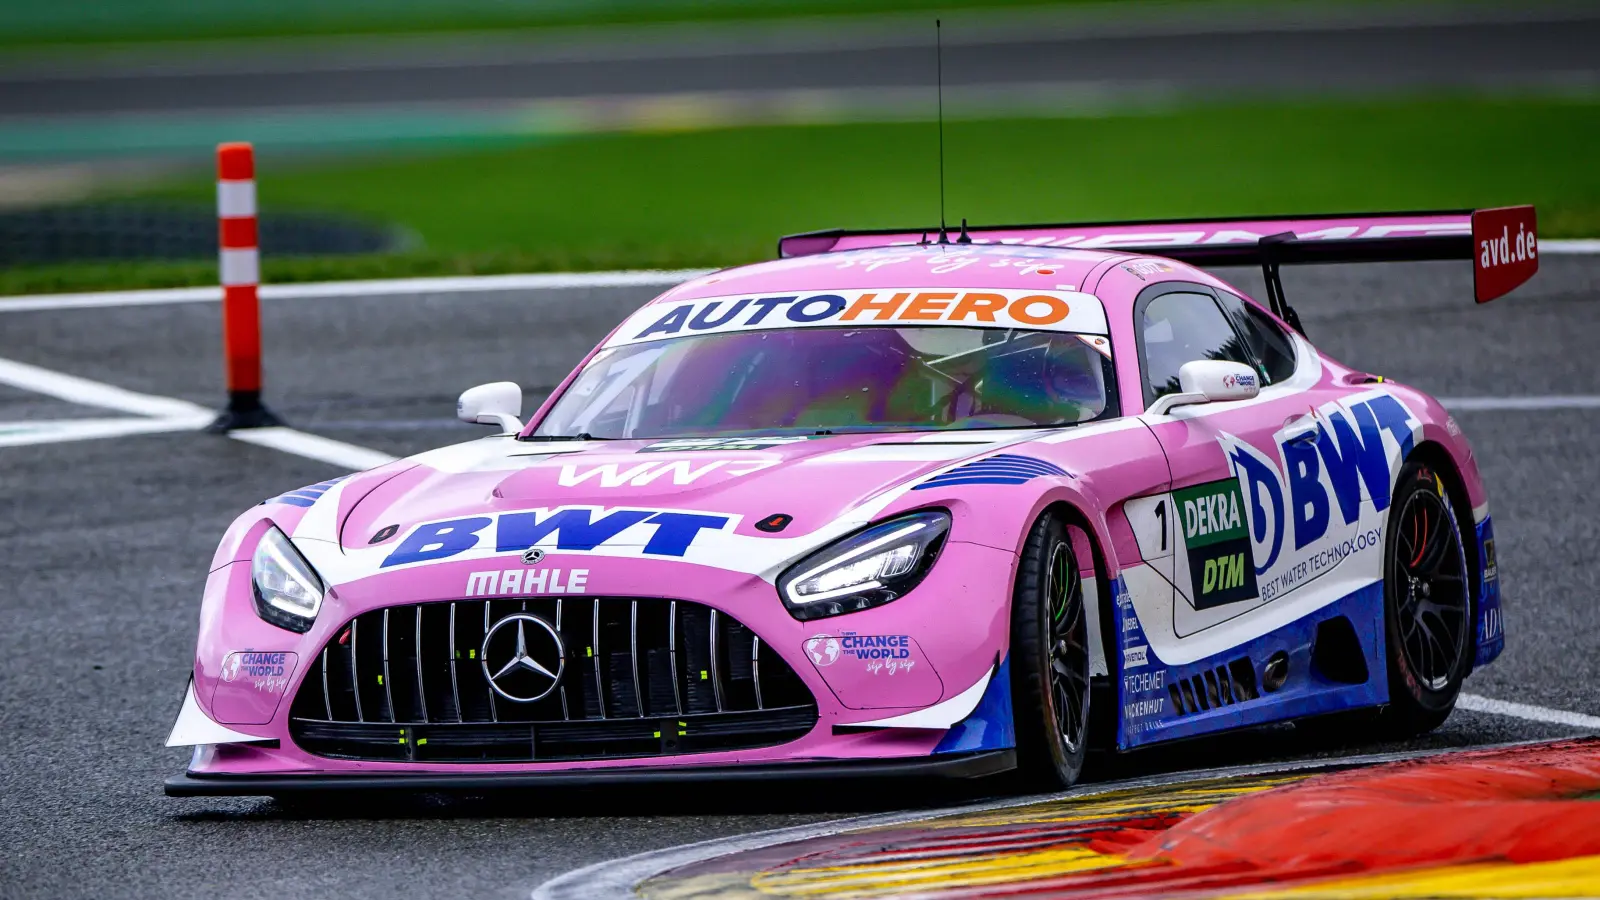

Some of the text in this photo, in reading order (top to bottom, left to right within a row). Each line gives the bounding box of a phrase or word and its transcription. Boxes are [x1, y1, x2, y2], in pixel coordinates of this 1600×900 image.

[1480, 222, 1536, 269] avd.de
[632, 292, 1070, 341] AUTOHERO
[1282, 394, 1413, 552] BWT
[1154, 499, 1168, 551] 1
[1184, 490, 1242, 539] DEKRA
[379, 508, 731, 569] BWT
[466, 568, 589, 597] MAHLE
[1202, 552, 1245, 595] DTM
[1261, 526, 1382, 602] BEST WATER TECHNOLOGY
[242, 653, 286, 665] CHANGE
[842, 635, 909, 648] CHANGE
[856, 649, 910, 660] WORLD
[249, 665, 284, 676] WORLD
[867, 654, 915, 676] sip by sip
[1128, 670, 1165, 694] TECHEMET
